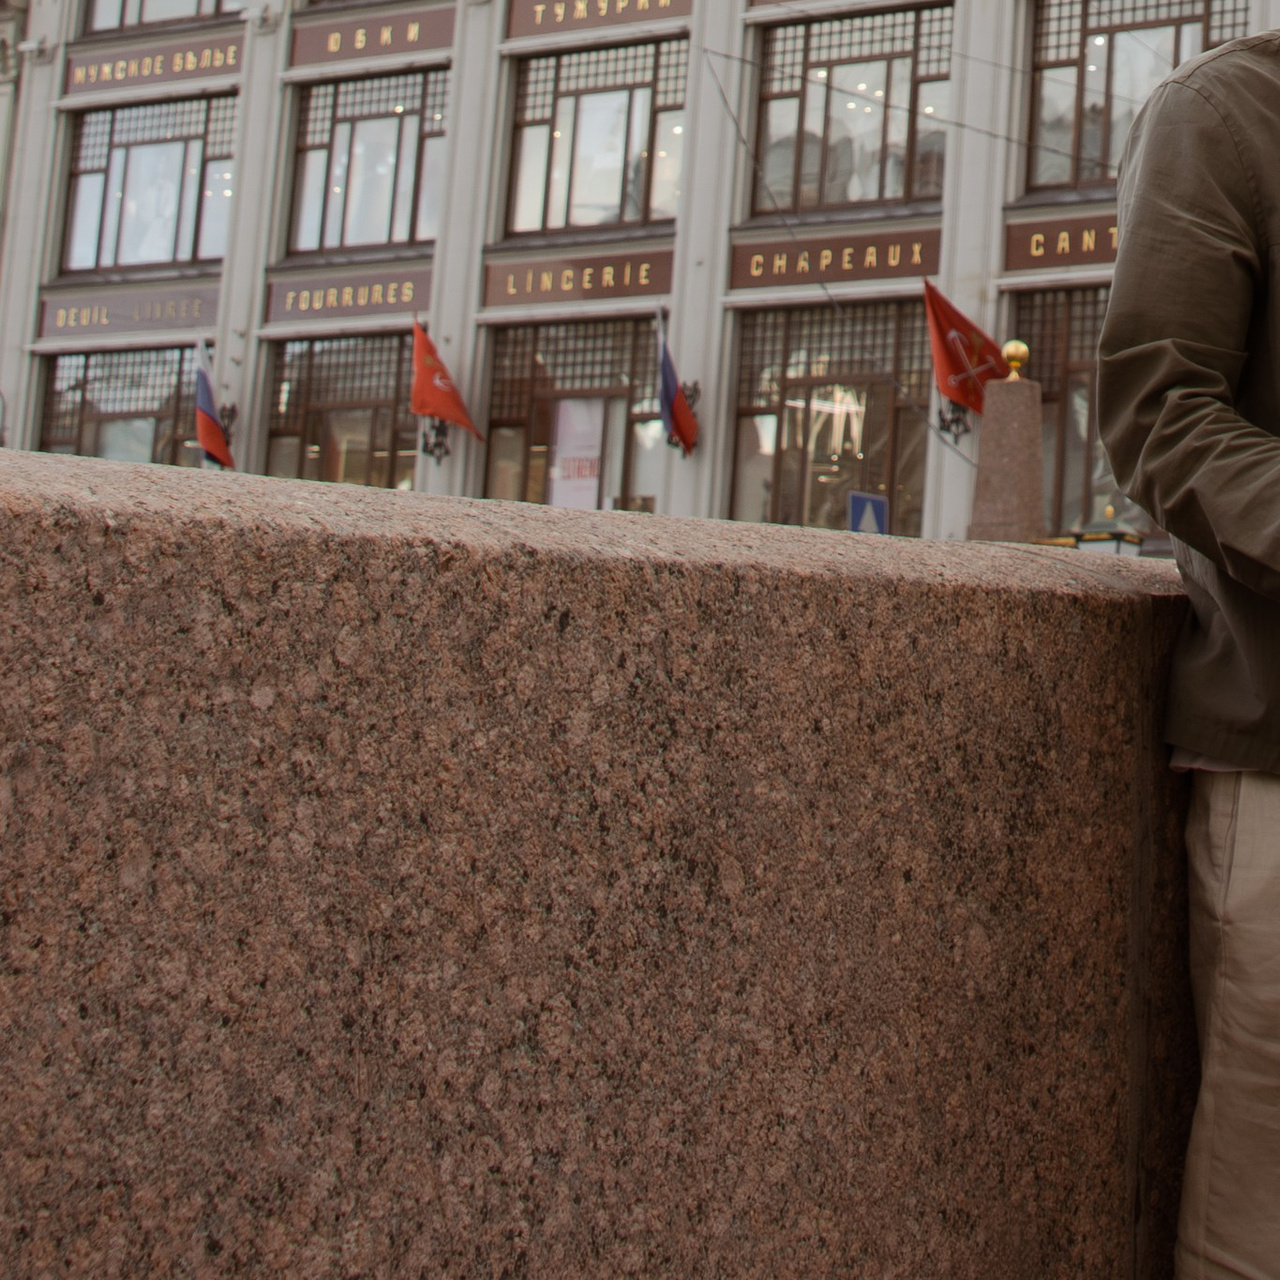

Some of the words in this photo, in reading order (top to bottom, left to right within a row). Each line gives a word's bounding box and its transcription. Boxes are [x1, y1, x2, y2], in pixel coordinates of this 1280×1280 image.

[327, 21, 420, 53] ЮБКИ
[73, 54, 164, 85] МУЖСКОЕ
[750, 242, 923, 278] CHAPEAUX
[285, 281, 415, 312] FOURRURES
[55, 305, 110, 329] DEUIL
